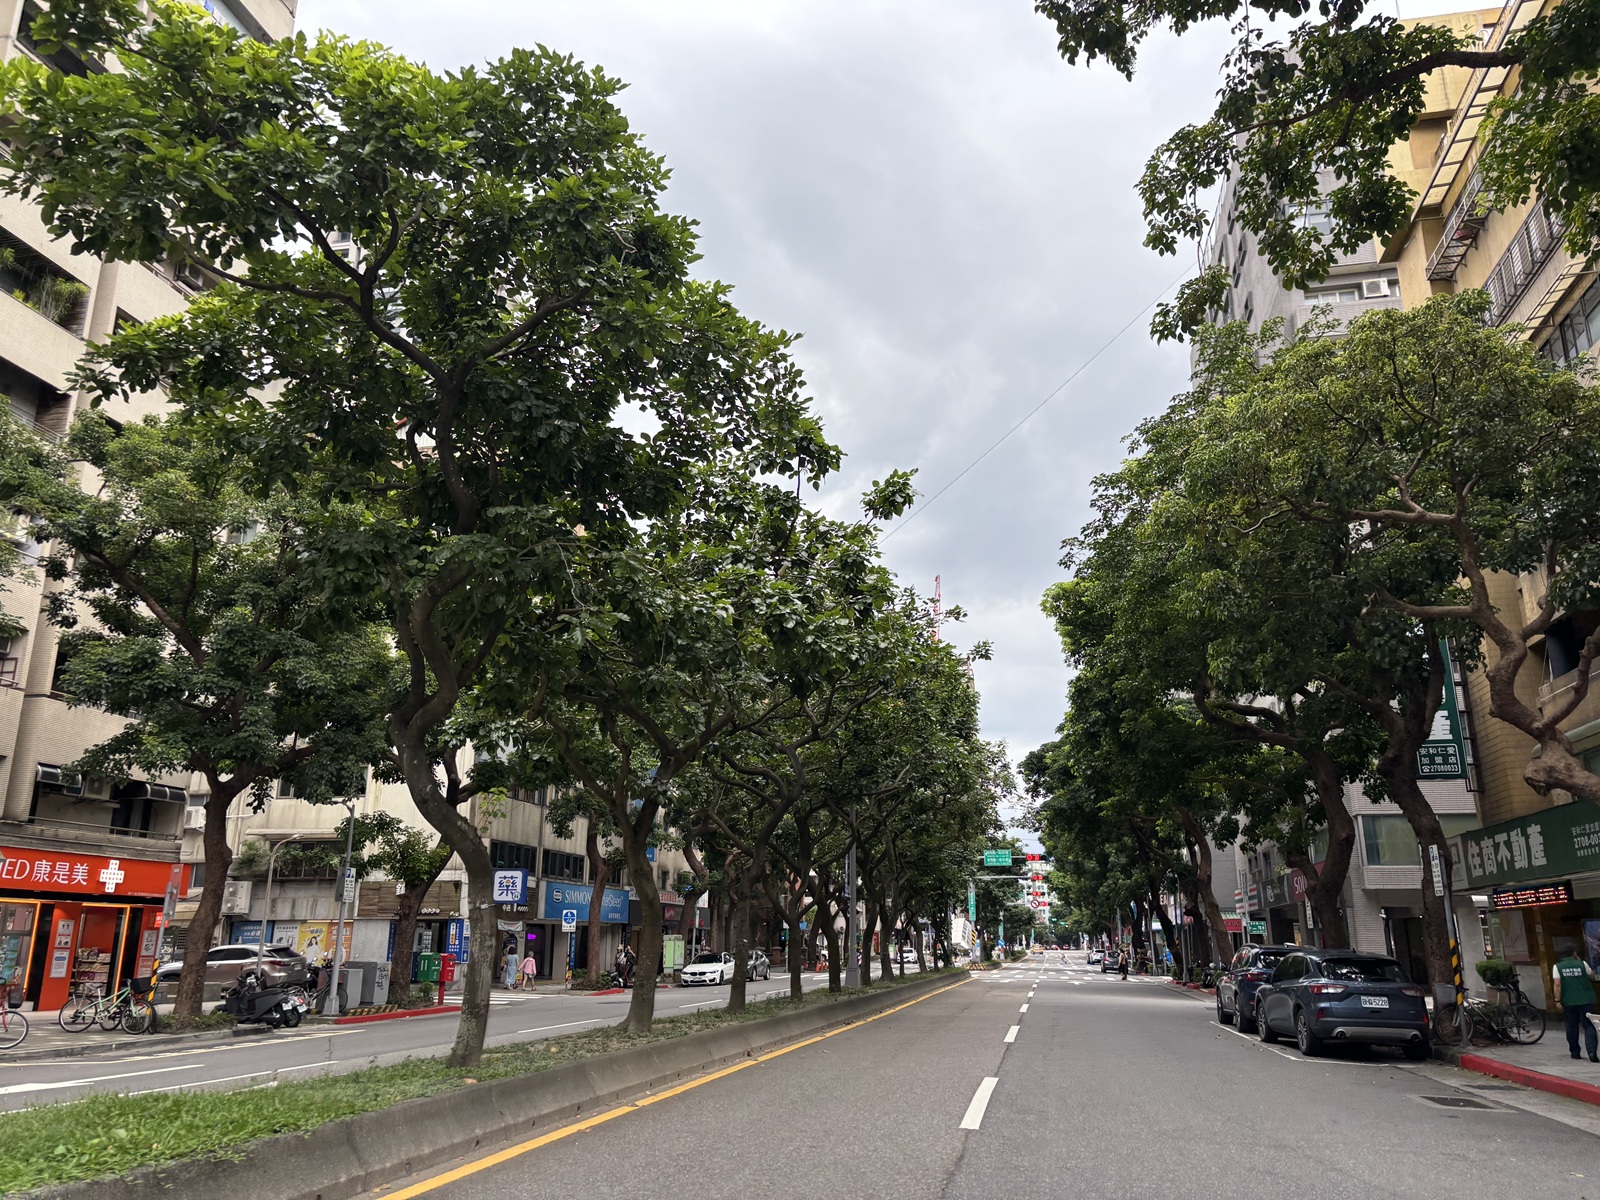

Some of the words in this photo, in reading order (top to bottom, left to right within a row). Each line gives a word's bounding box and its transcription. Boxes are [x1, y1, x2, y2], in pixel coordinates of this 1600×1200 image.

[1419, 747, 1456, 755] 安和仁愛
[1467, 823, 1547, 878] 住商不動產
[31, 859, 89, 886] 康是美
[498, 875, 519, 897] 藥
[565, 889, 592, 905] SIMMON
